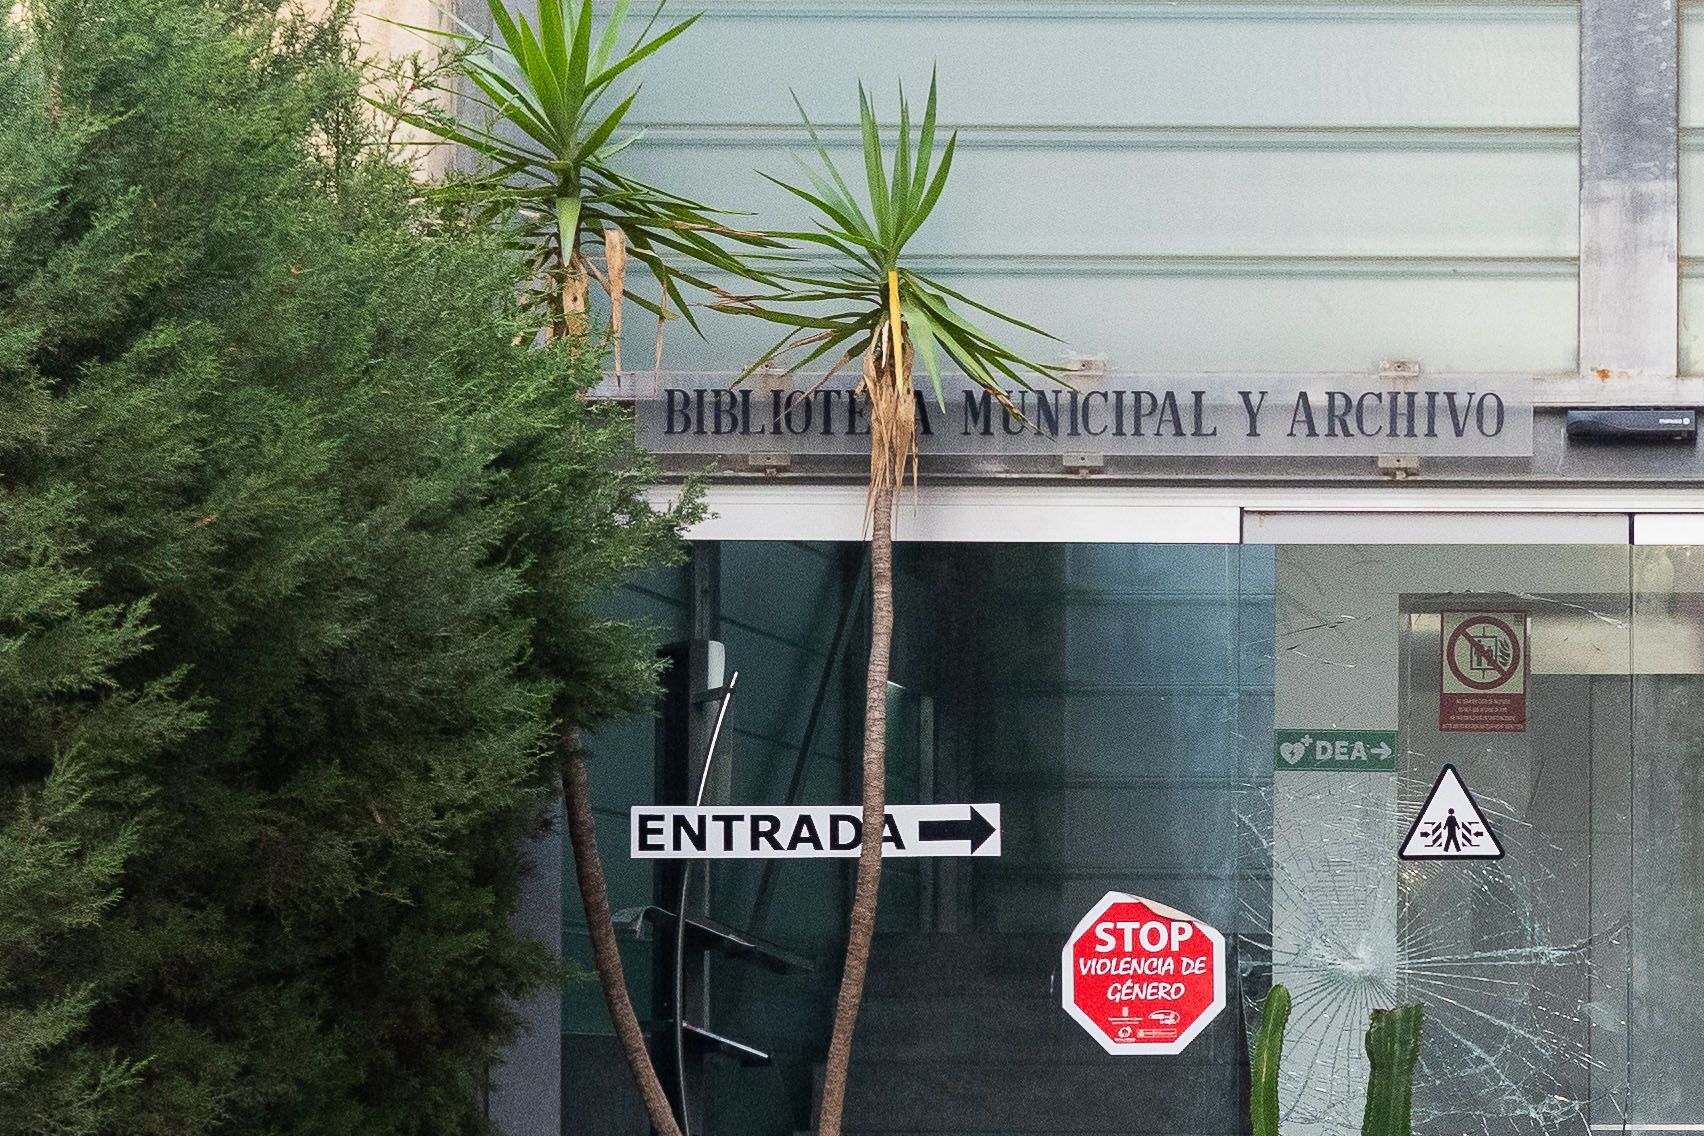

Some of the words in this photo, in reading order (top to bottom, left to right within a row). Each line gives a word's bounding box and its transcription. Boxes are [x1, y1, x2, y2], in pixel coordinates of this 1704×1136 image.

[664, 388, 935, 436] BIBLIOTEA
[961, 389, 1218, 437] MUNICIPAL
[1238, 390, 1267, 437] Y
[1287, 390, 1505, 438] ARCHIVO
[1315, 741, 1368, 761] DEA
[637, 813, 906, 852] ENTRADA
[1095, 921, 1193, 953] STOP
[1079, 957, 1175, 976] VIOLENCIA
[1181, 957, 1207, 975] DE
[1107, 979, 1186, 1003] GÉNERO
